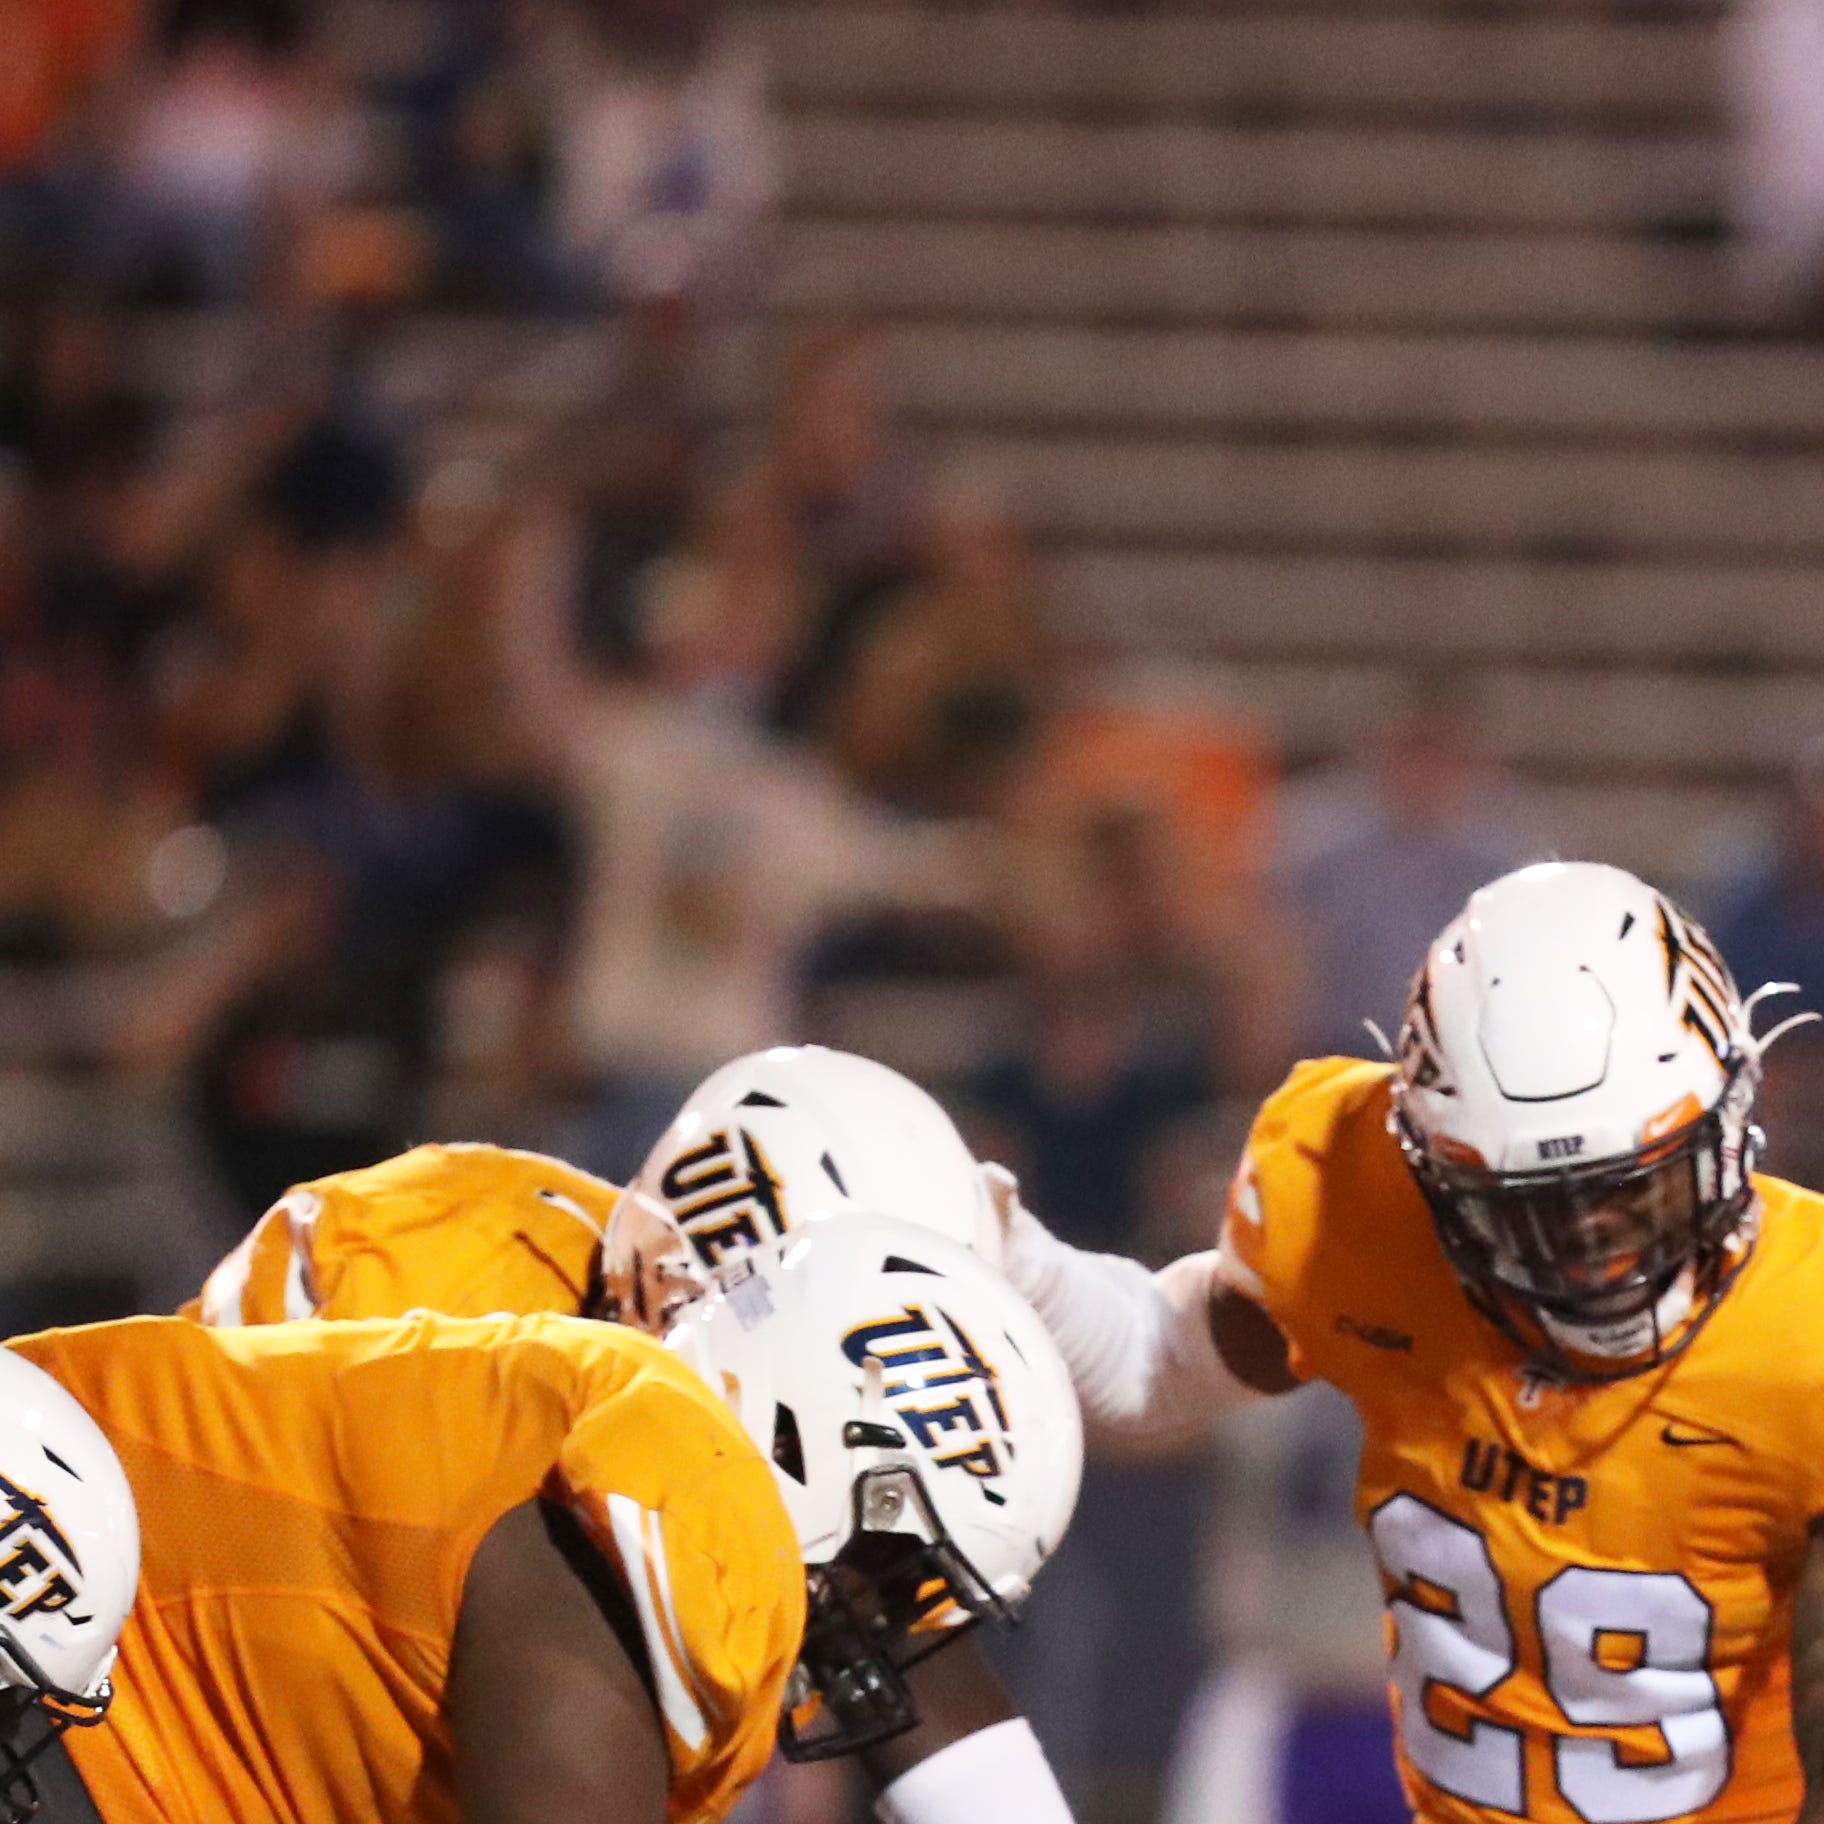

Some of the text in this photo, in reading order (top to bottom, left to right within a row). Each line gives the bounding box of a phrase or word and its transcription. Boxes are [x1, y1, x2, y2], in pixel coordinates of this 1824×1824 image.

[1538, 1135, 1585, 1159] UTEP
[840, 1302, 1010, 1478] UTEP
[1459, 1437, 1588, 1526] UTEP
